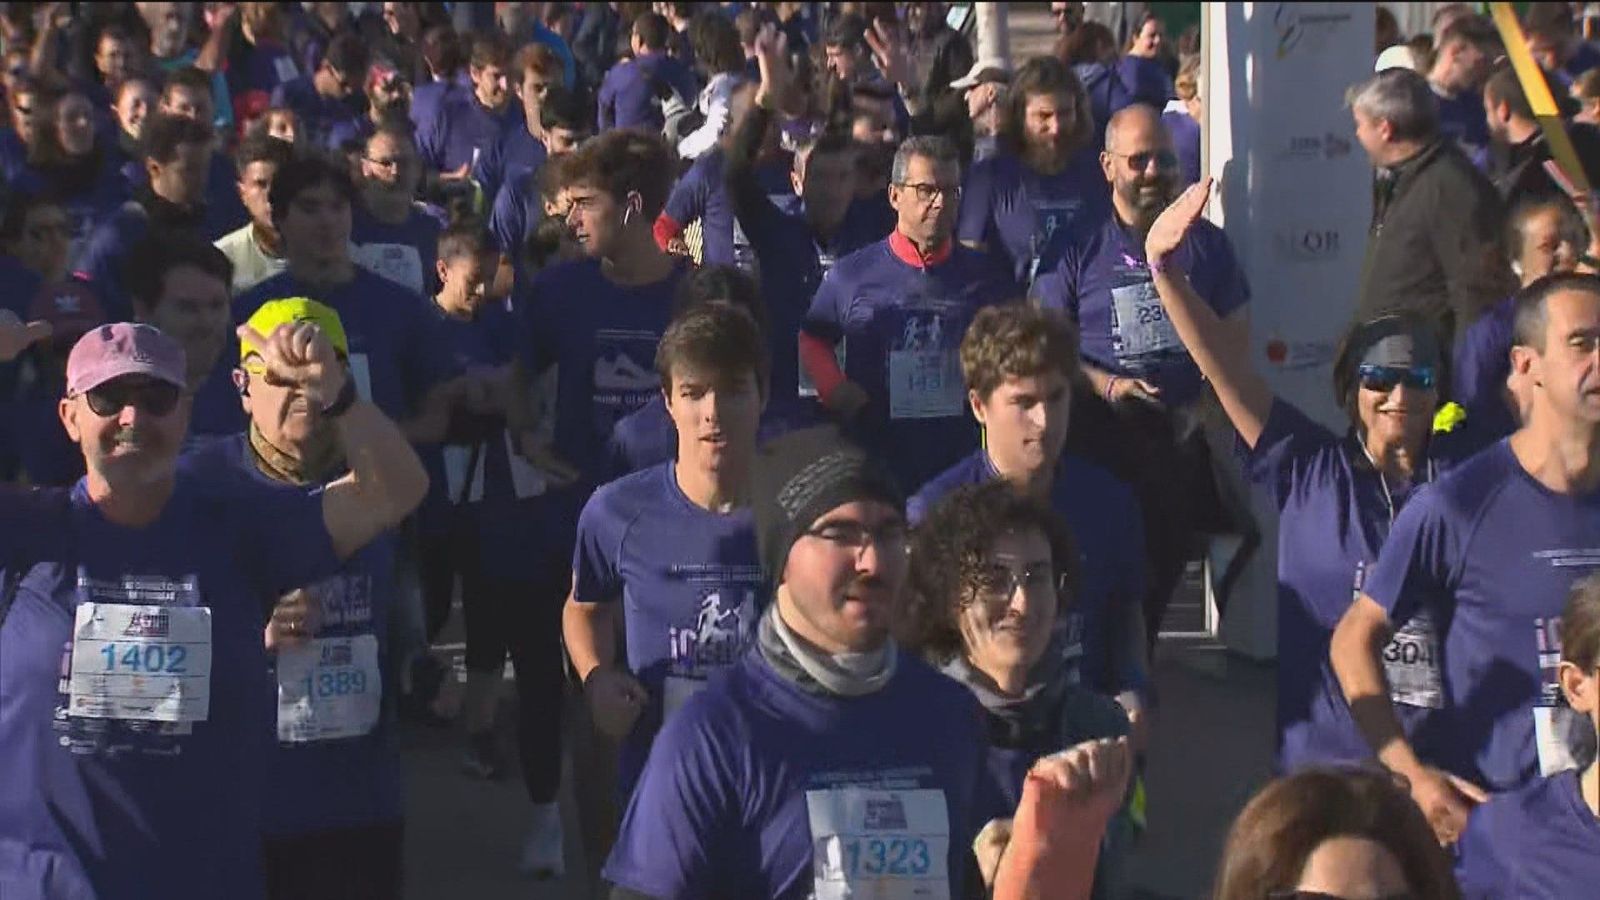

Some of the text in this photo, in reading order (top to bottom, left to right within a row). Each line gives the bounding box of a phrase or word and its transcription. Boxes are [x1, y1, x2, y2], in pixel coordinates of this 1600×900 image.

[101, 643, 187, 673] 1402
[302, 668, 367, 699] 1389
[846, 838, 931, 875] 1323
